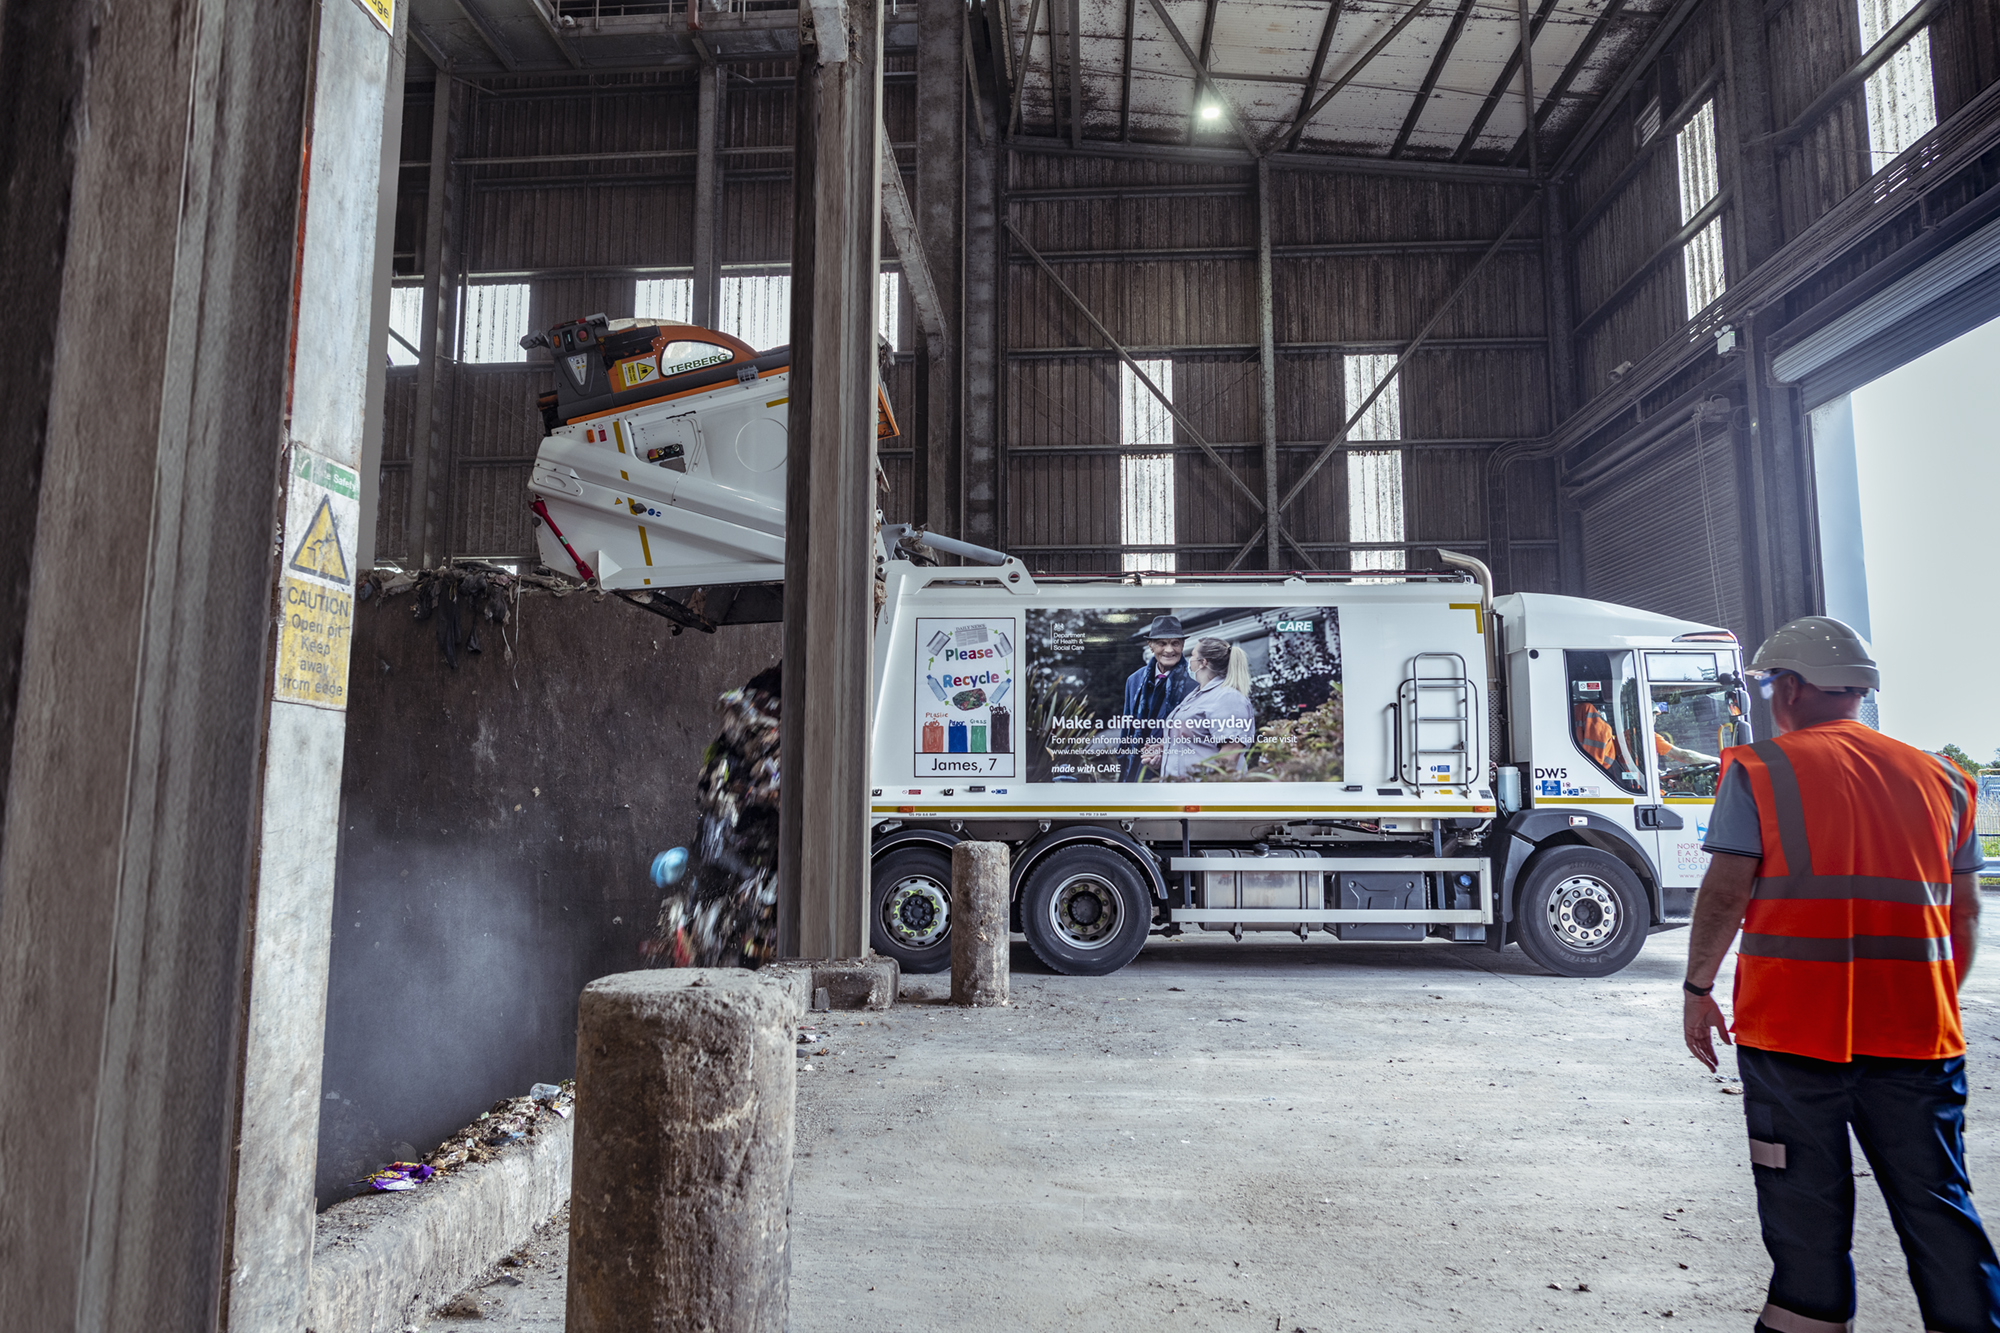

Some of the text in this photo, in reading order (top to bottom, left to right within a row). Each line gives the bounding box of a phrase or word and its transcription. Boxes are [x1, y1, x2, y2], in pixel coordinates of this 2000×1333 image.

[669, 353, 728, 373] TERBERG
[333, 474, 356, 492] Safety
[288, 586, 349, 617] CAUTION
[292, 614, 341, 639] Open pit
[1276, 621, 1312, 632] CARE
[301, 635, 331, 657] Keep
[945, 648, 993, 661] Please
[300, 660, 329, 676] away
[282, 673, 343, 698] from edge
[943, 671, 999, 688] Recycle
[1052, 715, 1252, 732] Make a difference everyday
[1051, 735, 1065, 744] For
[1092, 735, 1144, 744] information
[1145, 735, 1171, 744] about
[1173, 735, 1191, 746] jobs
[1193, 735, 1201, 744] in
[1203, 735, 1227, 744] Adult
[1229, 735, 1255, 744] Social
[1257, 735, 1278, 744] Care
[1279, 735, 1298, 744] visit
[1051, 747, 1196, 756] www.nelincs.gov.uk/adult-social-care-jobs
[931, 758, 997, 773] James, 7
[1051, 764, 1121, 773] made with CARE
[1534, 768, 1567, 779] DW5
